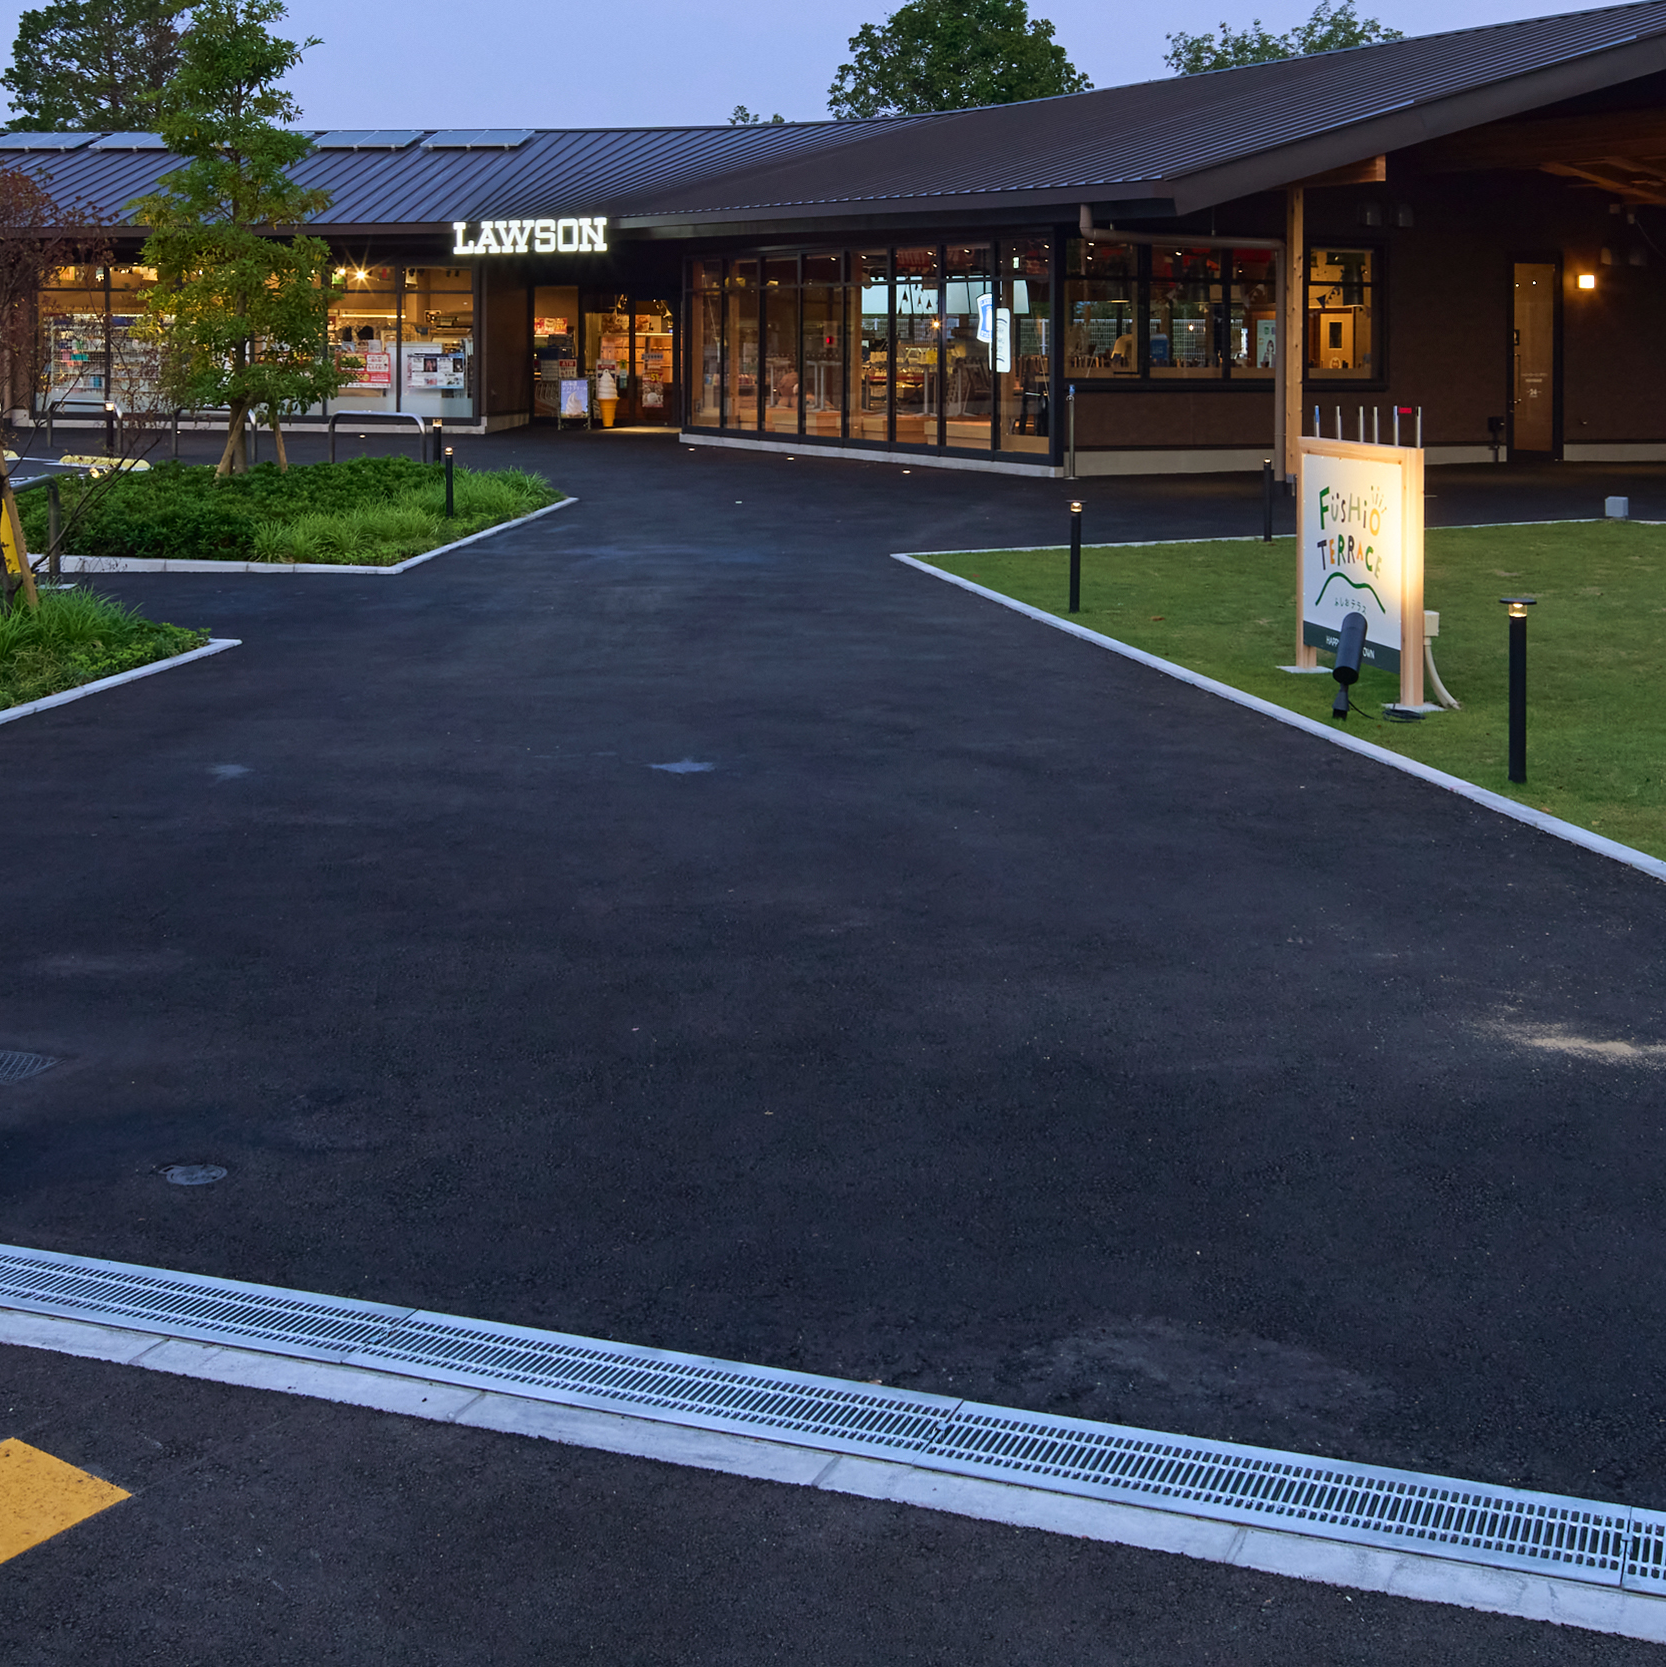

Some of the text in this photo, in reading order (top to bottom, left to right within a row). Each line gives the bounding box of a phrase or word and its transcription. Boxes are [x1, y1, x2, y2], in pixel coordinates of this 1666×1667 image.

[452, 217, 608, 255] LAWSON
[1317, 534, 1383, 580] TERRACE
[1334, 597, 1367, 615] ふしおテラス
[1325, 635, 1375, 660] HAPP OWN
